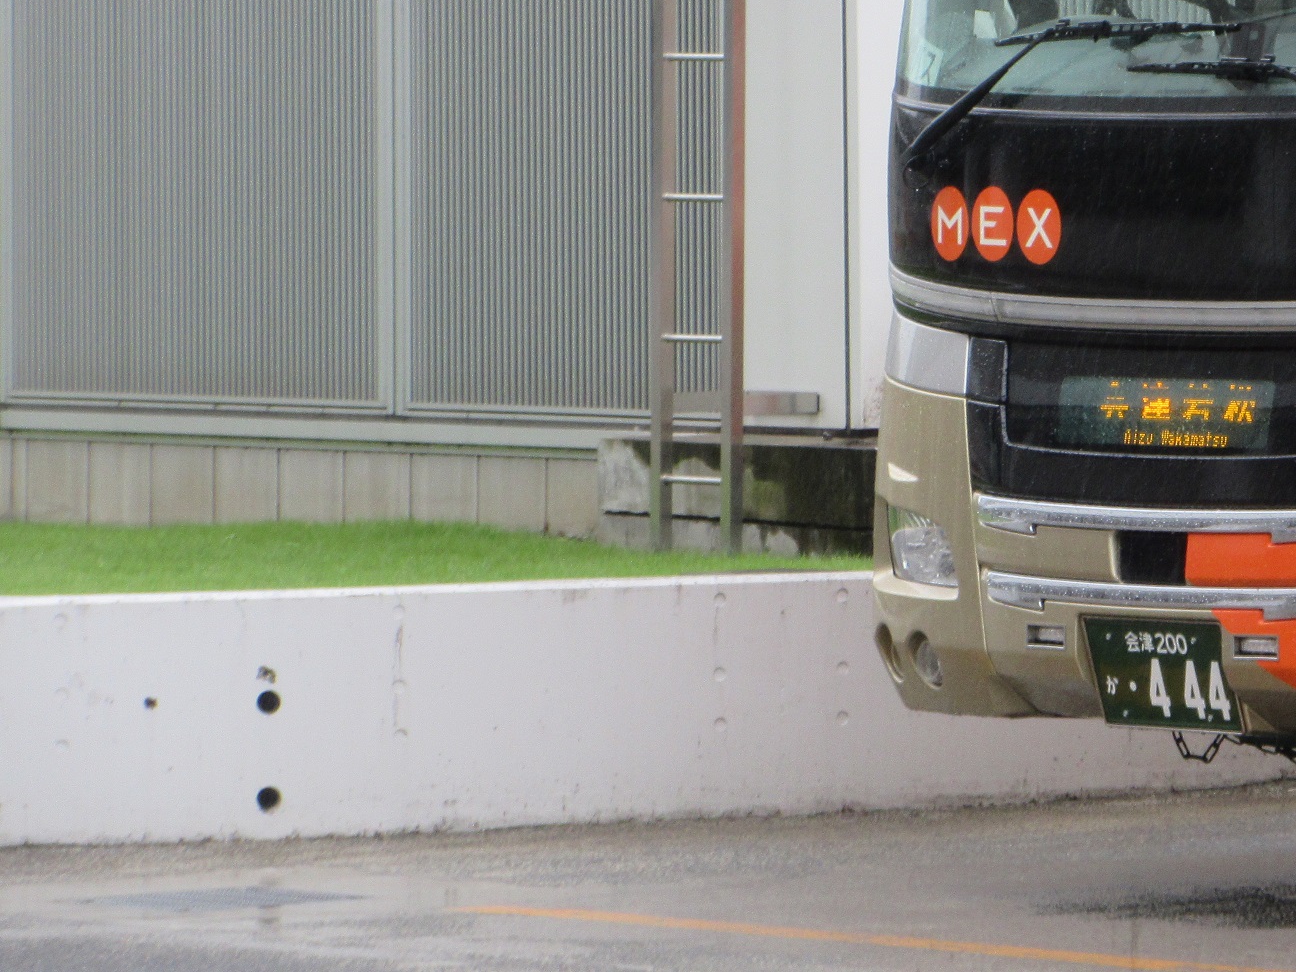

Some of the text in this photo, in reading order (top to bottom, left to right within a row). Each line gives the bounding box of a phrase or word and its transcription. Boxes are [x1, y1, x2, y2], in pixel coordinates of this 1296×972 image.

[936, 203, 1055, 250] MEX
[1123, 428, 1228, 448] Aizu Wakamatsu
[1106, 675, 1119, 696] か
